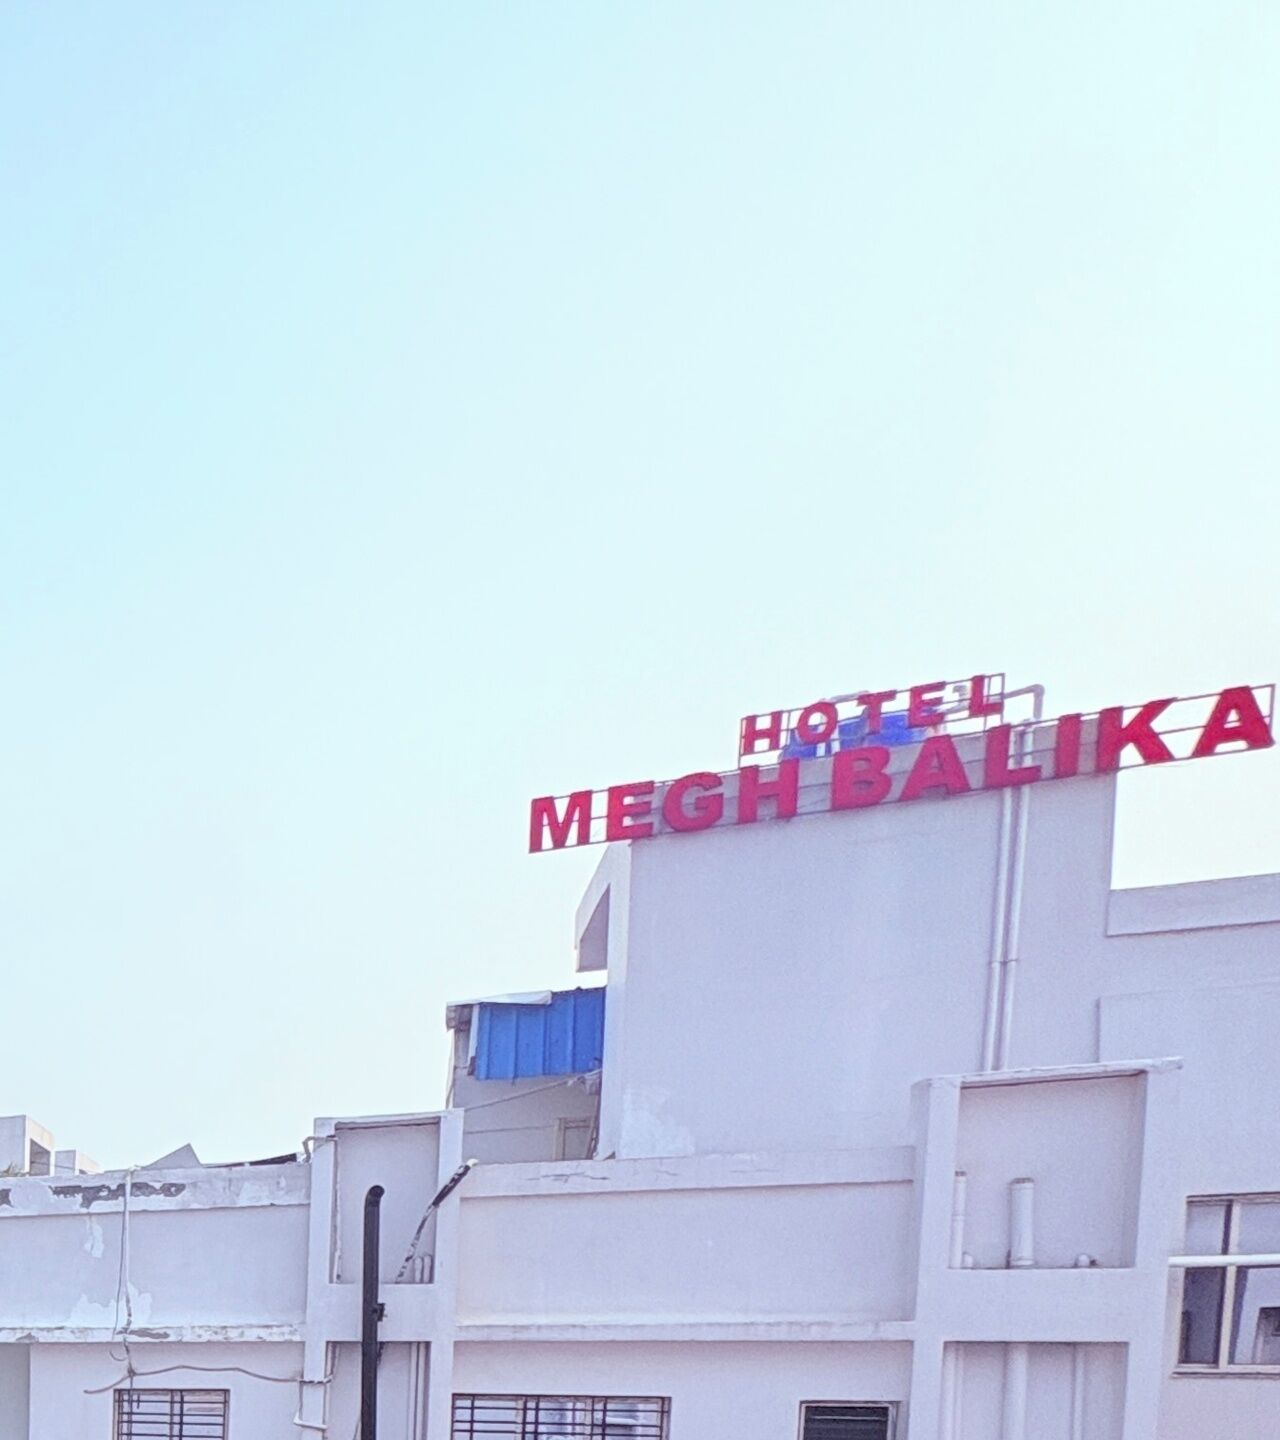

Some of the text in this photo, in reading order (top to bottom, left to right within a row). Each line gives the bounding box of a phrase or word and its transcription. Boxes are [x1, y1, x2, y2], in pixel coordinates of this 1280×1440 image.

[529, 685, 1275, 853] MEGH BALIKA
[741, 673, 1003, 756] HOTEL
